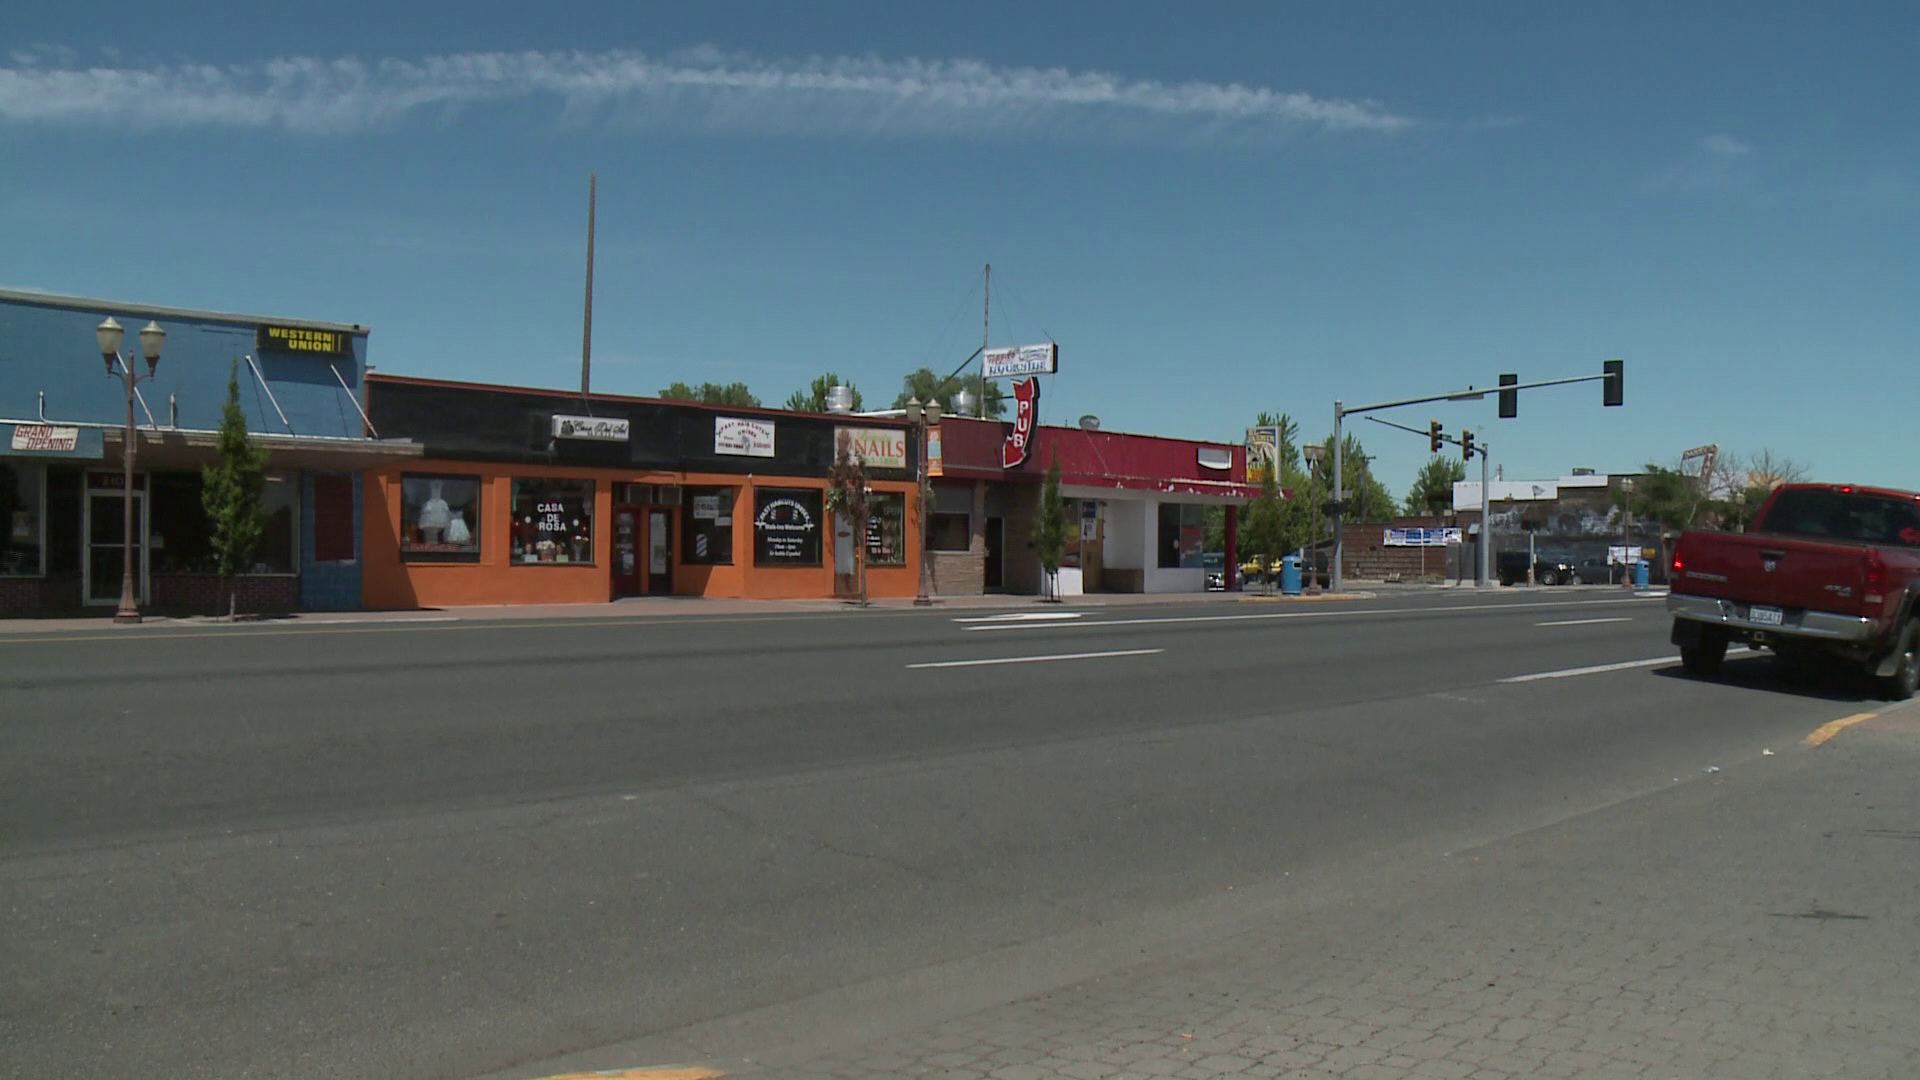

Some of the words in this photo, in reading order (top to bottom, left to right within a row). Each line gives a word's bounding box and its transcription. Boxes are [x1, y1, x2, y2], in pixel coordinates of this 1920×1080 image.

[268, 327, 332, 342] WESTERN
[288, 340, 332, 351] UNION
[1013, 400, 1029, 448] PUB
[15, 425, 54, 440] GRAND
[26, 436, 74, 450] OPENING
[854, 438, 904, 458] NAILS
[537, 503, 564, 513] CASA
[547, 513, 560, 523] DE
[538, 522, 567, 532] ROSA
